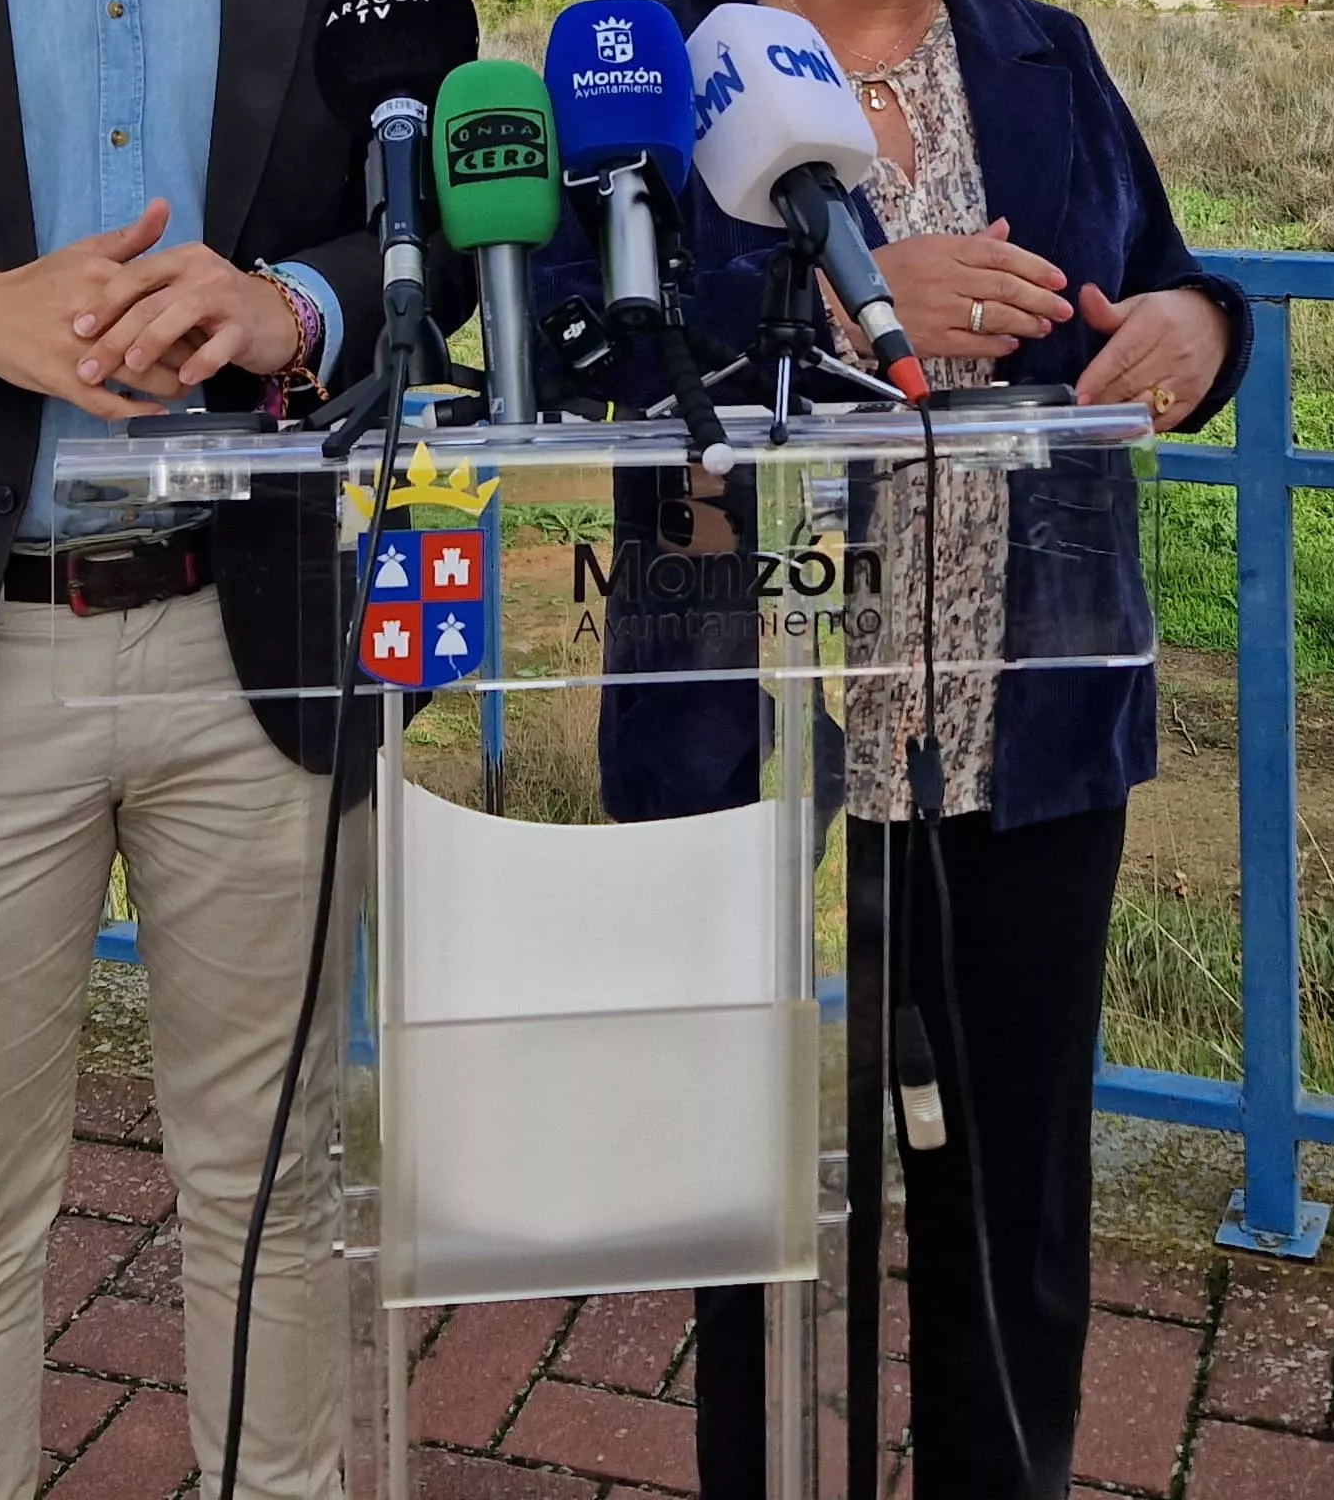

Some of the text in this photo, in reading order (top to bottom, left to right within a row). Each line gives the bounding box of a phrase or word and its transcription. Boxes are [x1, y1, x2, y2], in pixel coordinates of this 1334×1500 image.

[356, 3, 391, 24] TV
[766, 44, 842, 88] CMN
[572, 66, 662, 90] Monzón
[574, 83, 663, 100] Ayuntamiento
[459, 124, 533, 142] ONDA
[463, 148, 538, 171] CERO
[573, 533, 882, 603] Monzón
[573, 604, 883, 644] Ayuntamiento
